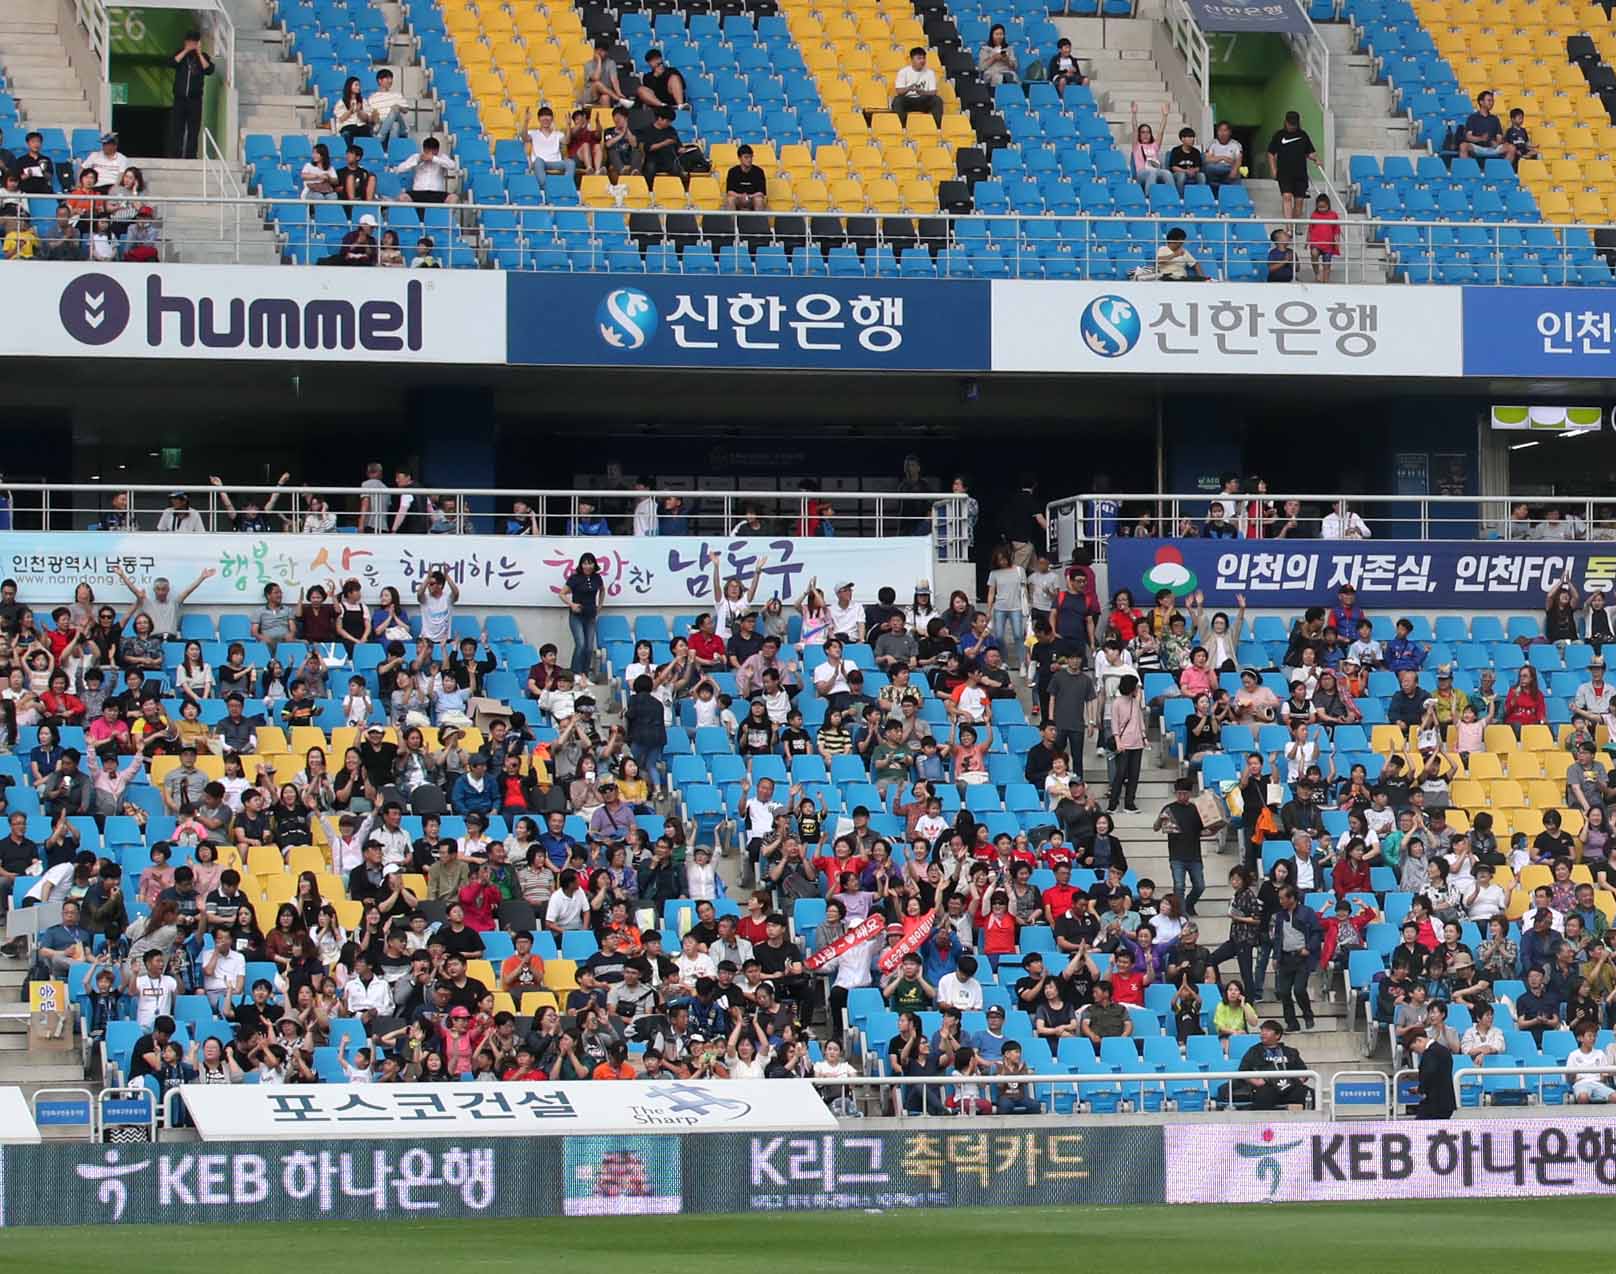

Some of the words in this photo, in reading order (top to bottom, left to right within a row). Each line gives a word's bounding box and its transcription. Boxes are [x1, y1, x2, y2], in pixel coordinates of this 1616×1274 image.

[146, 273, 423, 352] hummel
[666, 293, 903, 352] 신한은행
[1148, 300, 1378, 358] 신한은행
[12, 555, 97, 574] 인천광역시
[105, 555, 155, 574] 남동구
[668, 540, 804, 599] 남동구
[1215, 553, 1320, 591] 인천의
[1327, 555, 1438, 592] 자존심,
[266, 1090, 579, 1123] 포스코건설
[630, 1105, 665, 1116] The
[632, 1113, 700, 1126] Sharp
[159, 1152, 270, 1206] KEB
[281, 1147, 496, 1212] 하나은행
[751, 1136, 889, 1192] K리그
[901, 1131, 1089, 1191] 축덕카드
[1311, 1133, 1414, 1182] KEB
